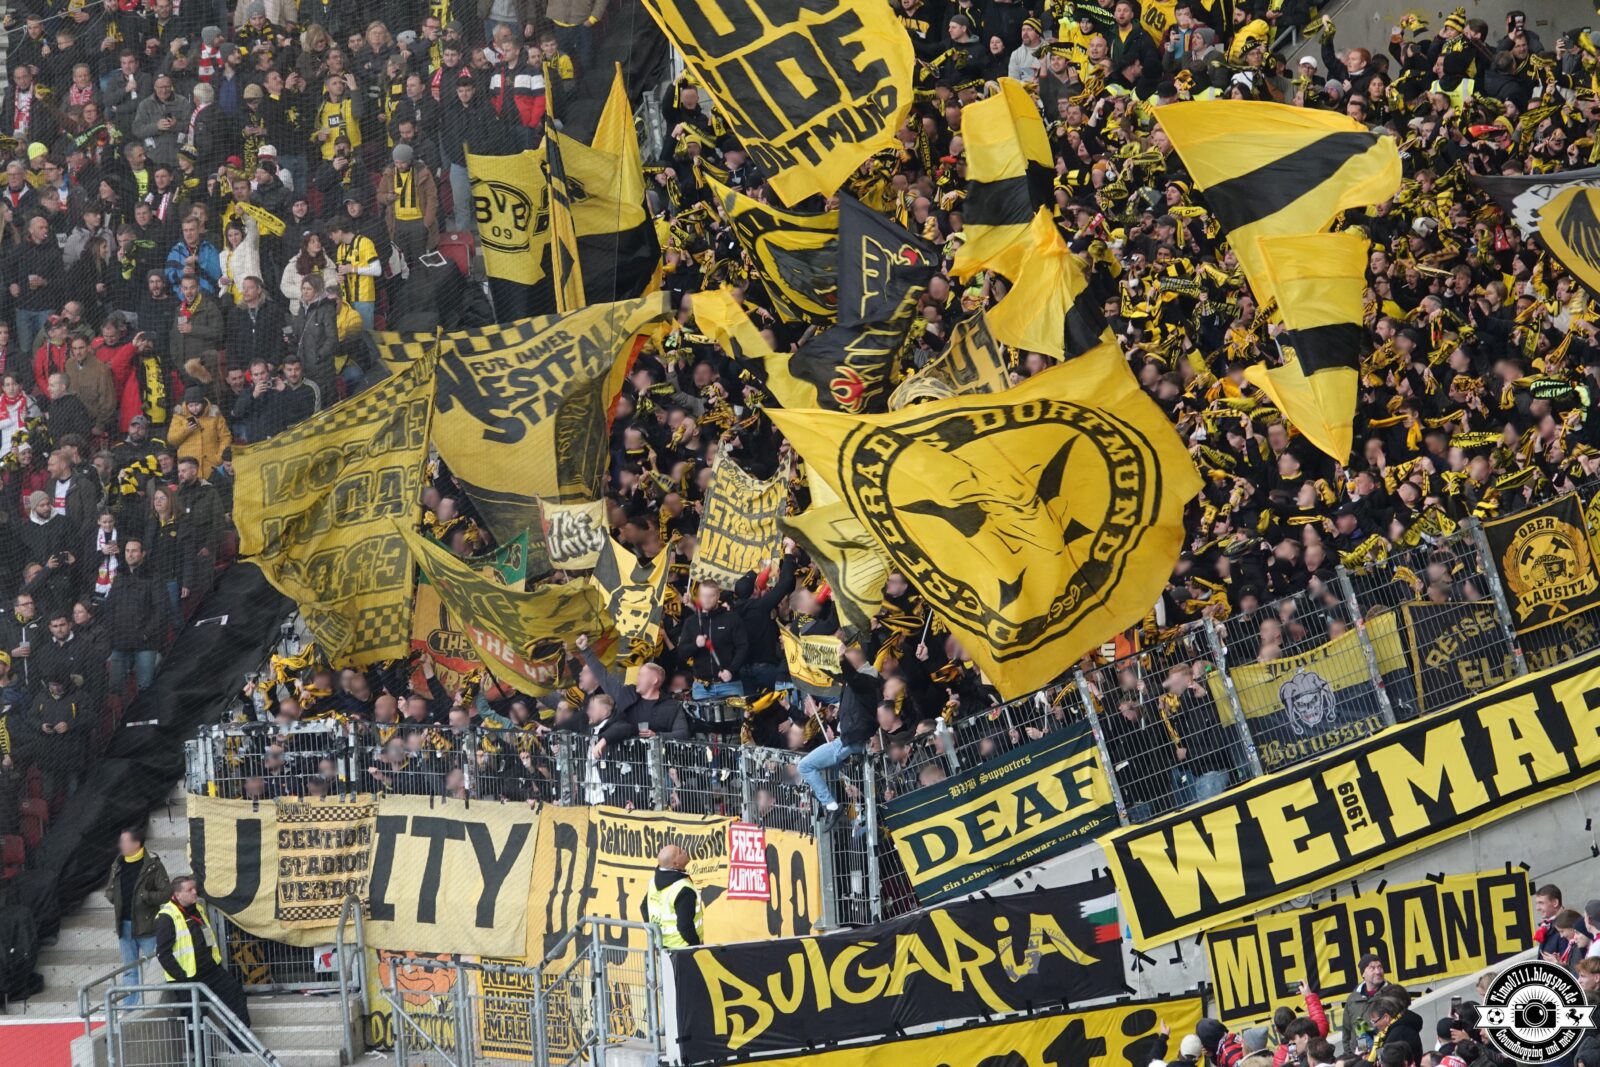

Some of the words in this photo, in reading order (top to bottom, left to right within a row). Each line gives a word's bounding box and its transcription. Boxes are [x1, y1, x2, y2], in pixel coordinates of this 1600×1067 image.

[473, 190, 528, 232] BVB
[491, 225, 513, 240] 09
[515, 330, 575, 364] IMMER
[967, 403, 1140, 562] DORTMUND
[1518, 518, 1555, 539] OBER
[1522, 578, 1588, 608] LAUSITZ
[438, 633, 469, 650] THE
[473, 628, 515, 664] THE
[1258, 715, 1384, 769] Borussen
[948, 780, 977, 800] BVB
[979, 754, 1032, 785] Supporters
[900, 756, 1100, 876] DEAF
[1336, 780, 1370, 833] 1909
[600, 818, 643, 858] Sektion
[731, 829, 765, 862] FREE
[942, 880, 961, 893] Ein
[962, 865, 994, 884] Leben
[1016, 838, 1058, 863] schwarz
[1058, 830, 1079, 843] und
[1079, 819, 1101, 838] gelb
[188, 814, 533, 929] UITY
[279, 850, 371, 877] STADION
[1212, 882, 1522, 1014] MEERANE
